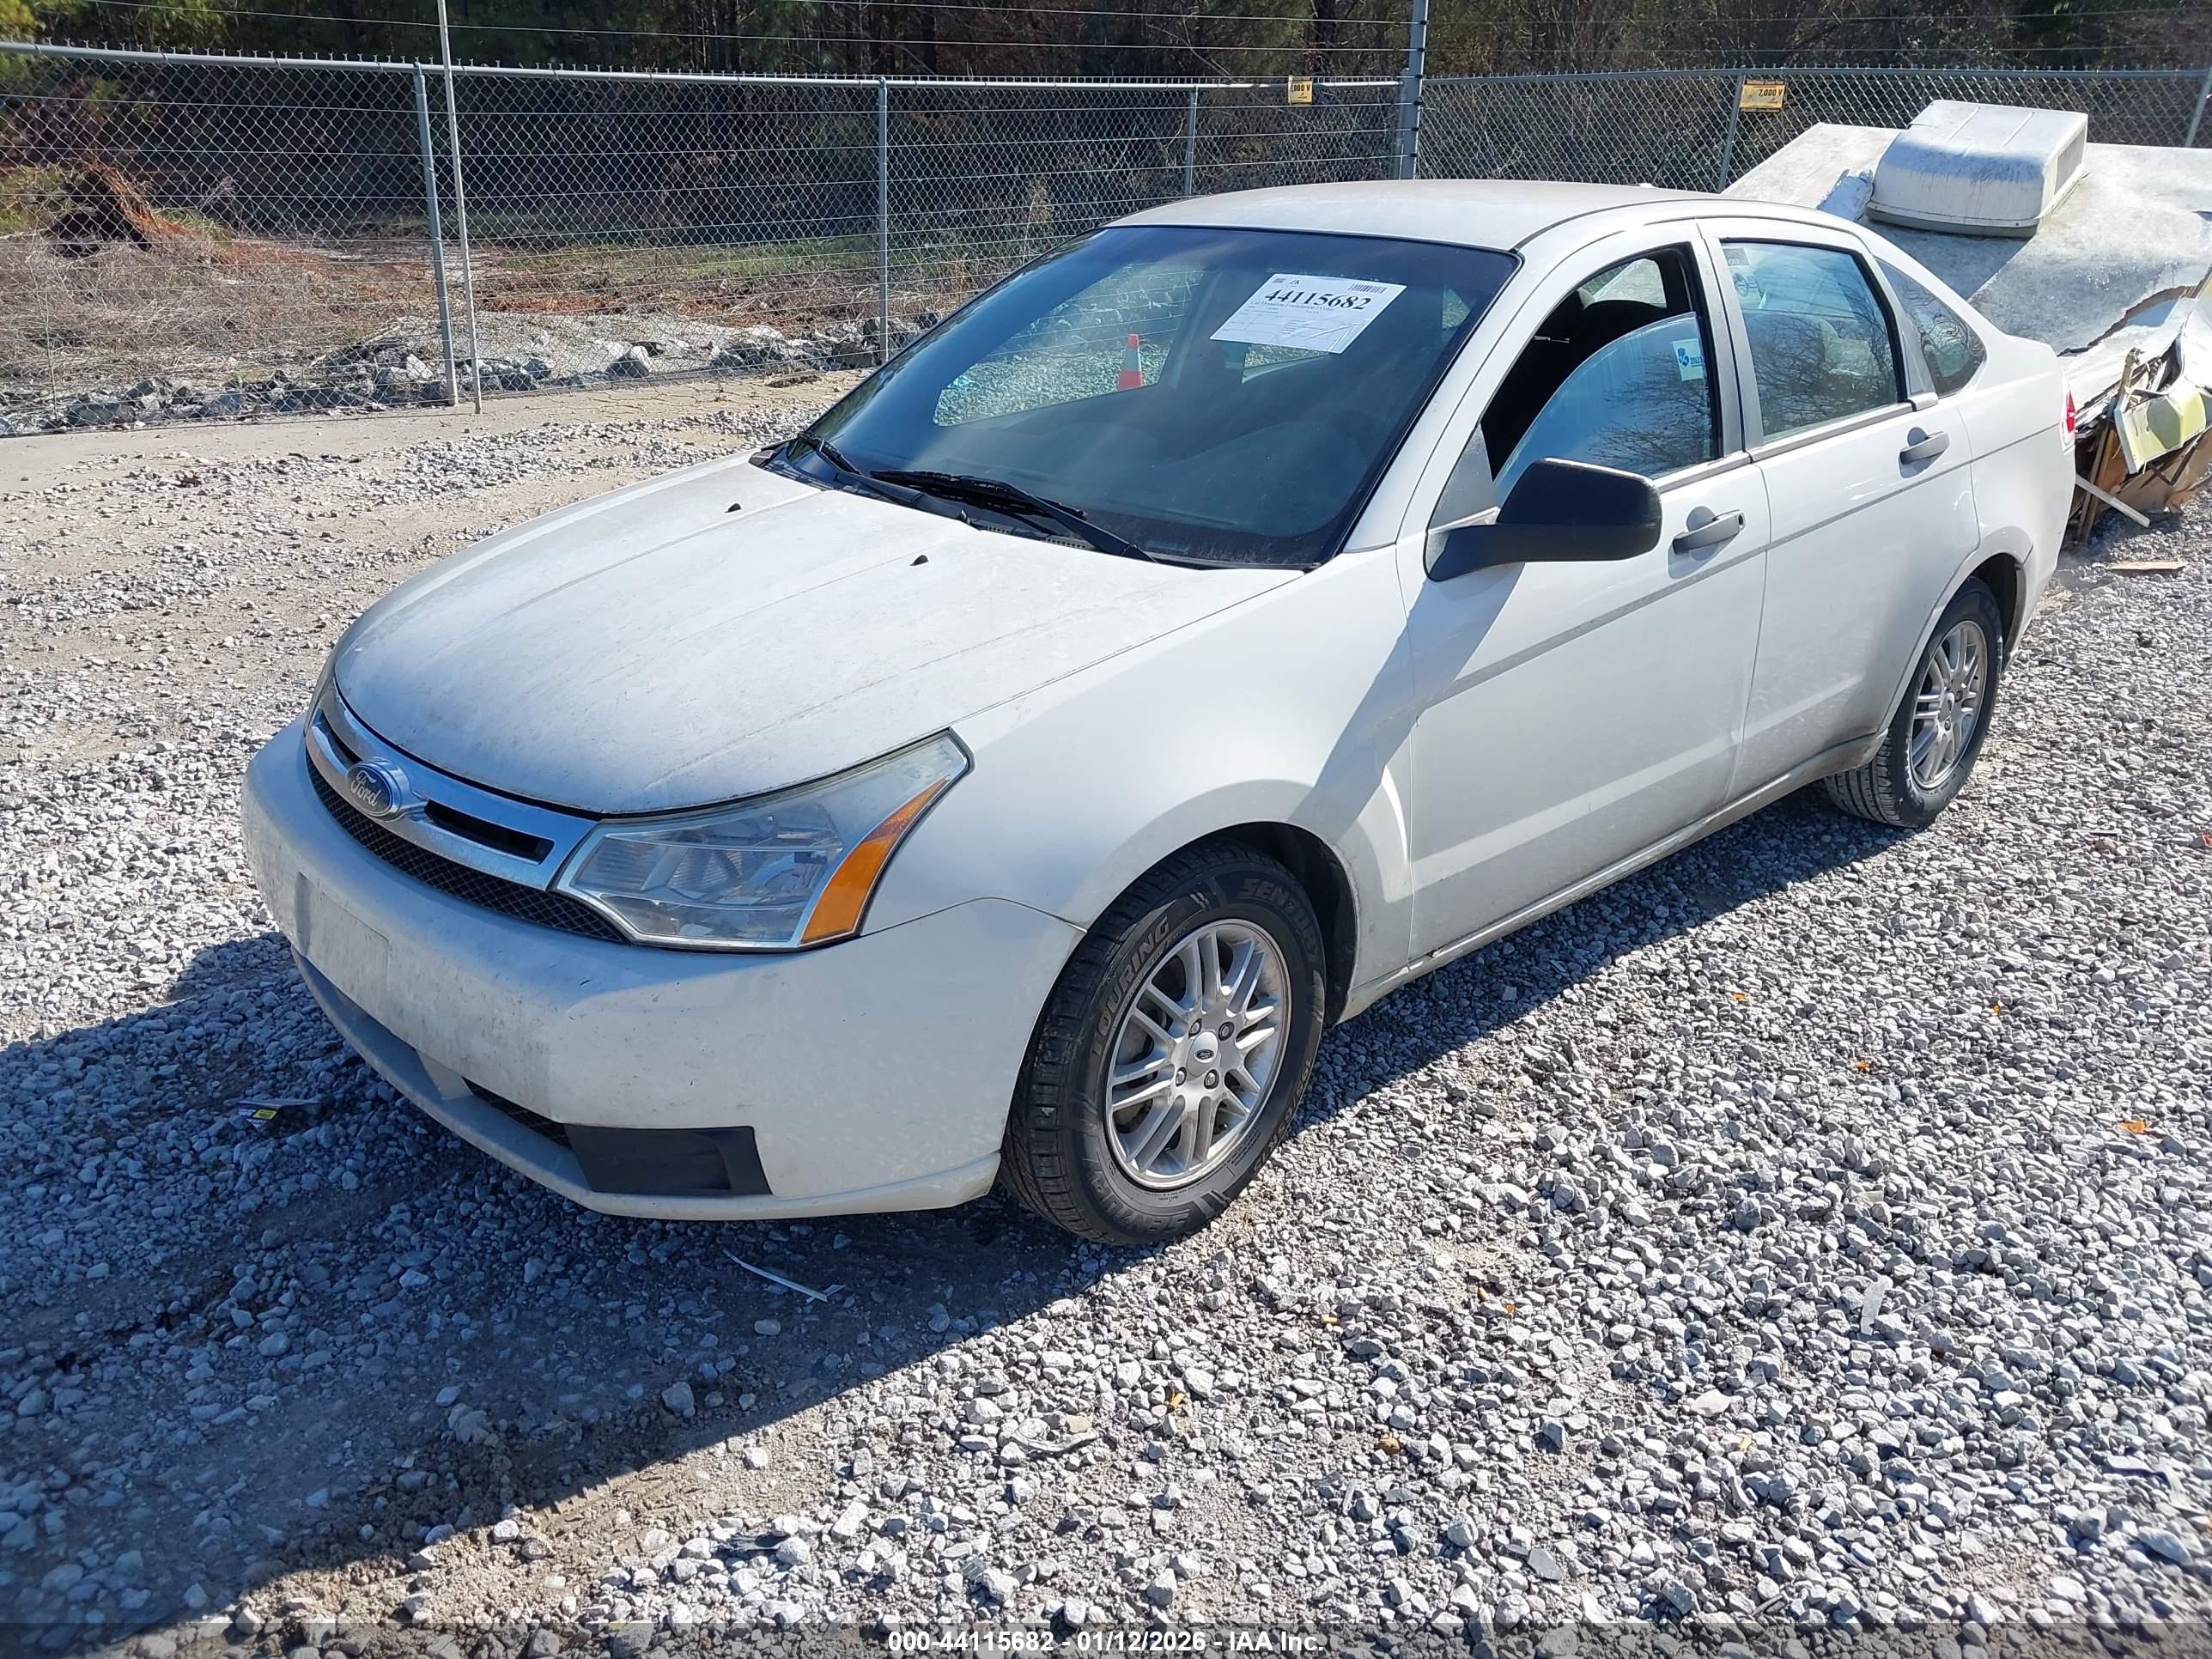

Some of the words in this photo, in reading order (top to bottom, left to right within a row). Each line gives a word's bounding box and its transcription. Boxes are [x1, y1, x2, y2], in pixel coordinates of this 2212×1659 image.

[1758, 88, 1778, 97] 7,000
[1778, 88, 1784, 97] V
[1265, 289, 1371, 310] 44115682
[350, 770, 381, 806] Ford
[1091, 915, 1170, 1057] TOURING
